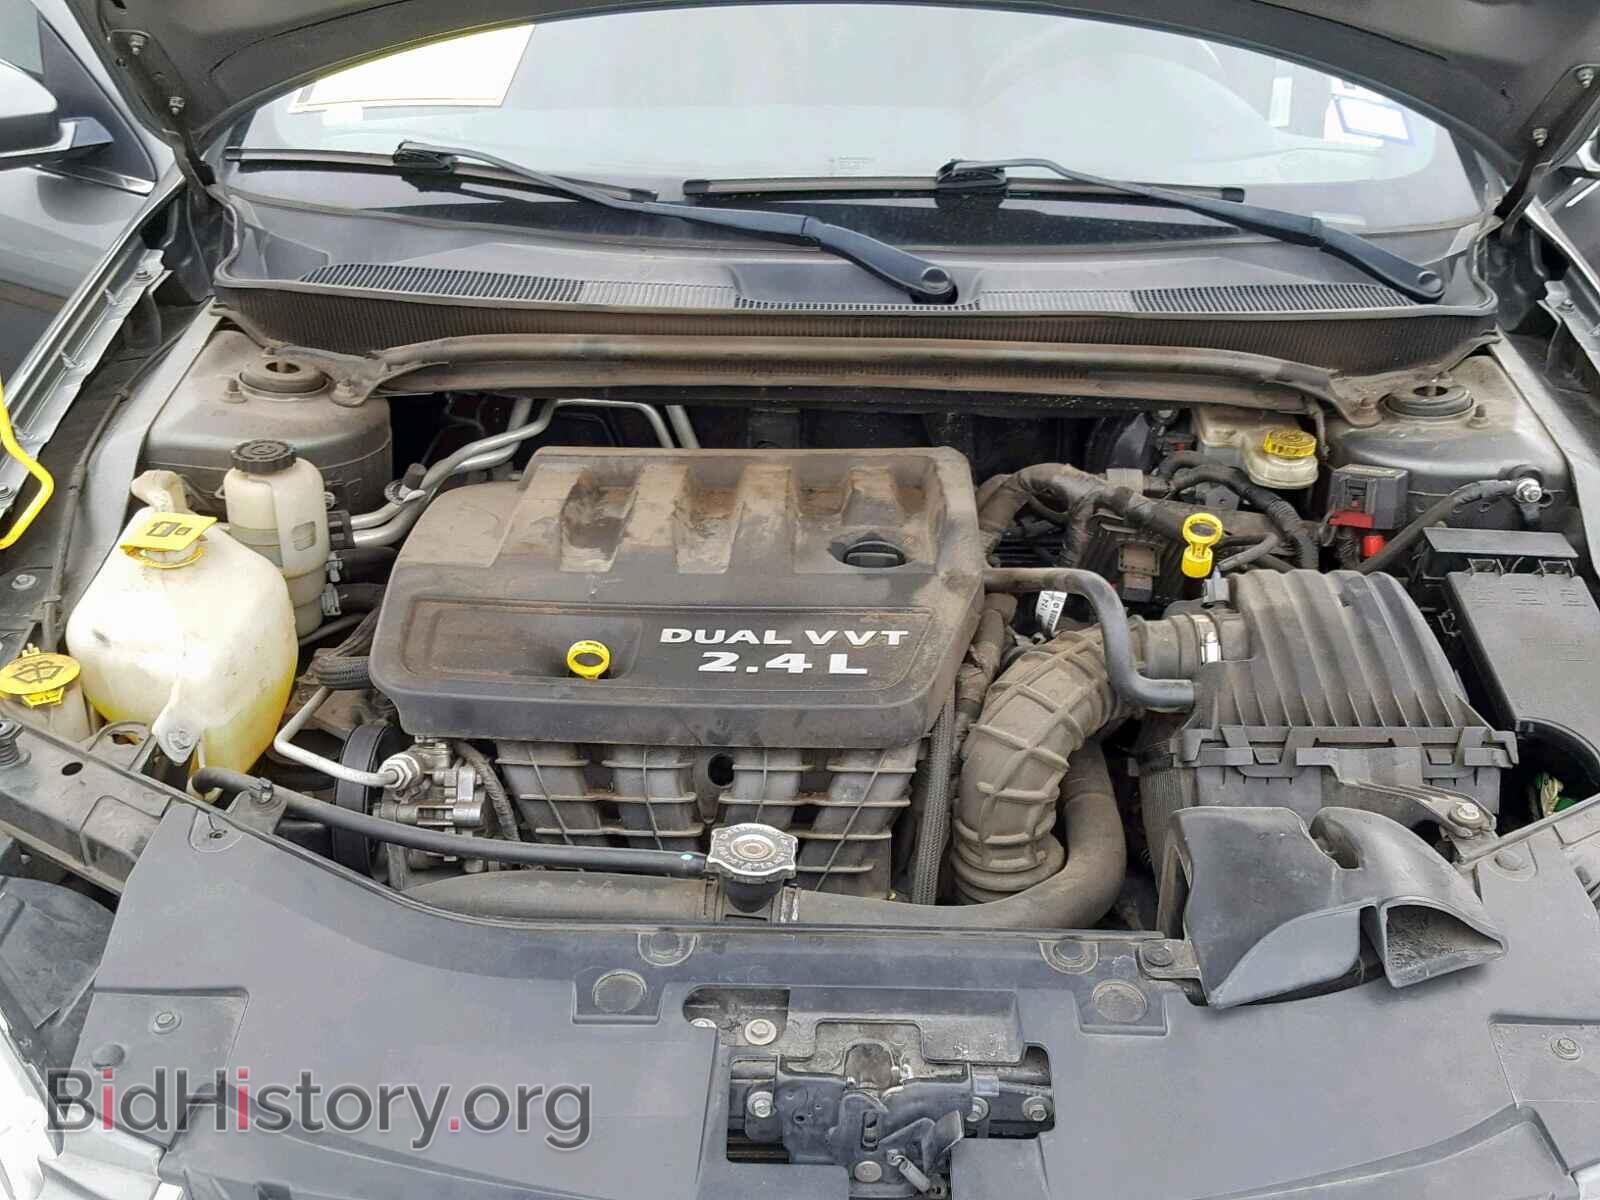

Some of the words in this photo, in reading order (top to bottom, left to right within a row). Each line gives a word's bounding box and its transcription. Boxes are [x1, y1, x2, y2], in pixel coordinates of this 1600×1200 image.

[660, 628, 792, 645] DUAL
[805, 630, 909, 645] VVT
[698, 652, 813, 673] 2.4
